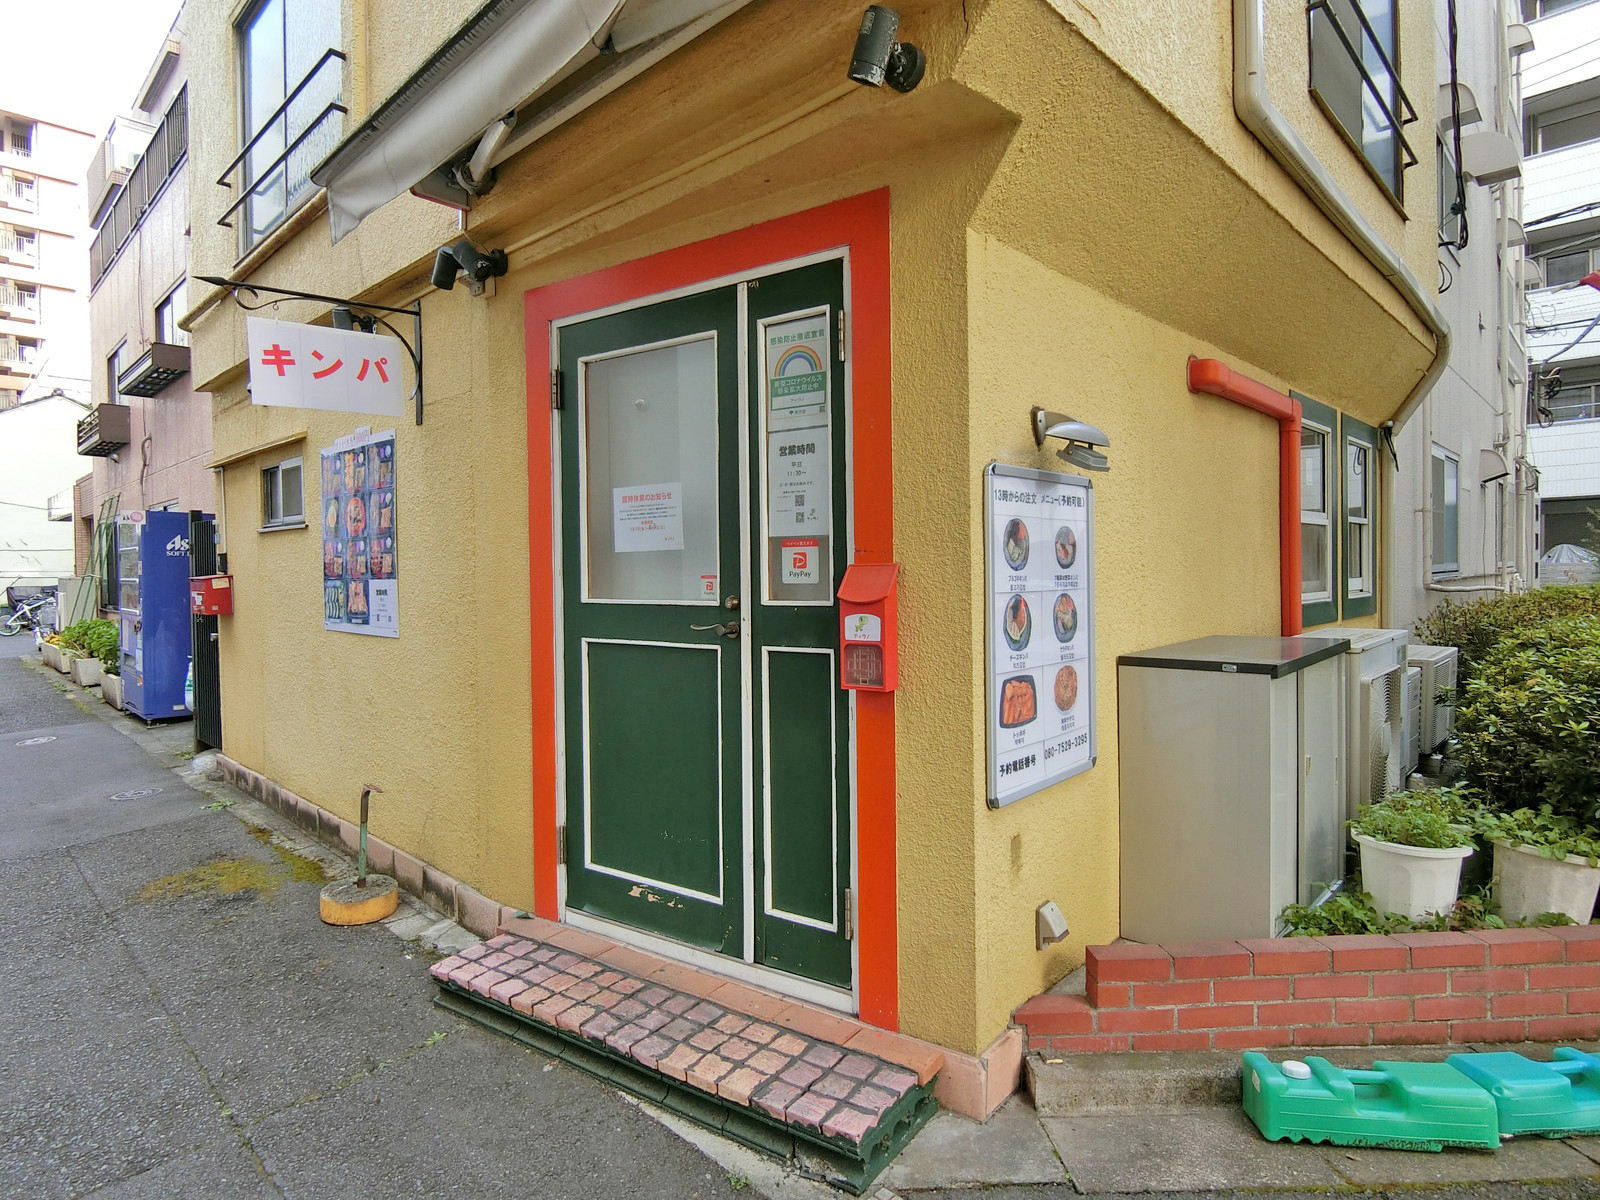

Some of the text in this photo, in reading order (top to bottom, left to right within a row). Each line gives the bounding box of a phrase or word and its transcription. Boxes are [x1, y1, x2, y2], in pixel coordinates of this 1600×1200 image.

[770, 329, 825, 345] 感染防止徹底宣言
[261, 343, 390, 384] キンパ
[774, 375, 822, 388] 新型コロナウイルス
[777, 383, 819, 395] 感染拡大防止中
[778, 442, 816, 457] 営業時間
[994, 489, 1037, 505] 13時からの注文
[789, 570, 811, 579] PayPay
[1044, 733, 1088, 760] 080-7529-3295
[999, 754, 1036, 777] 予約電話番号
